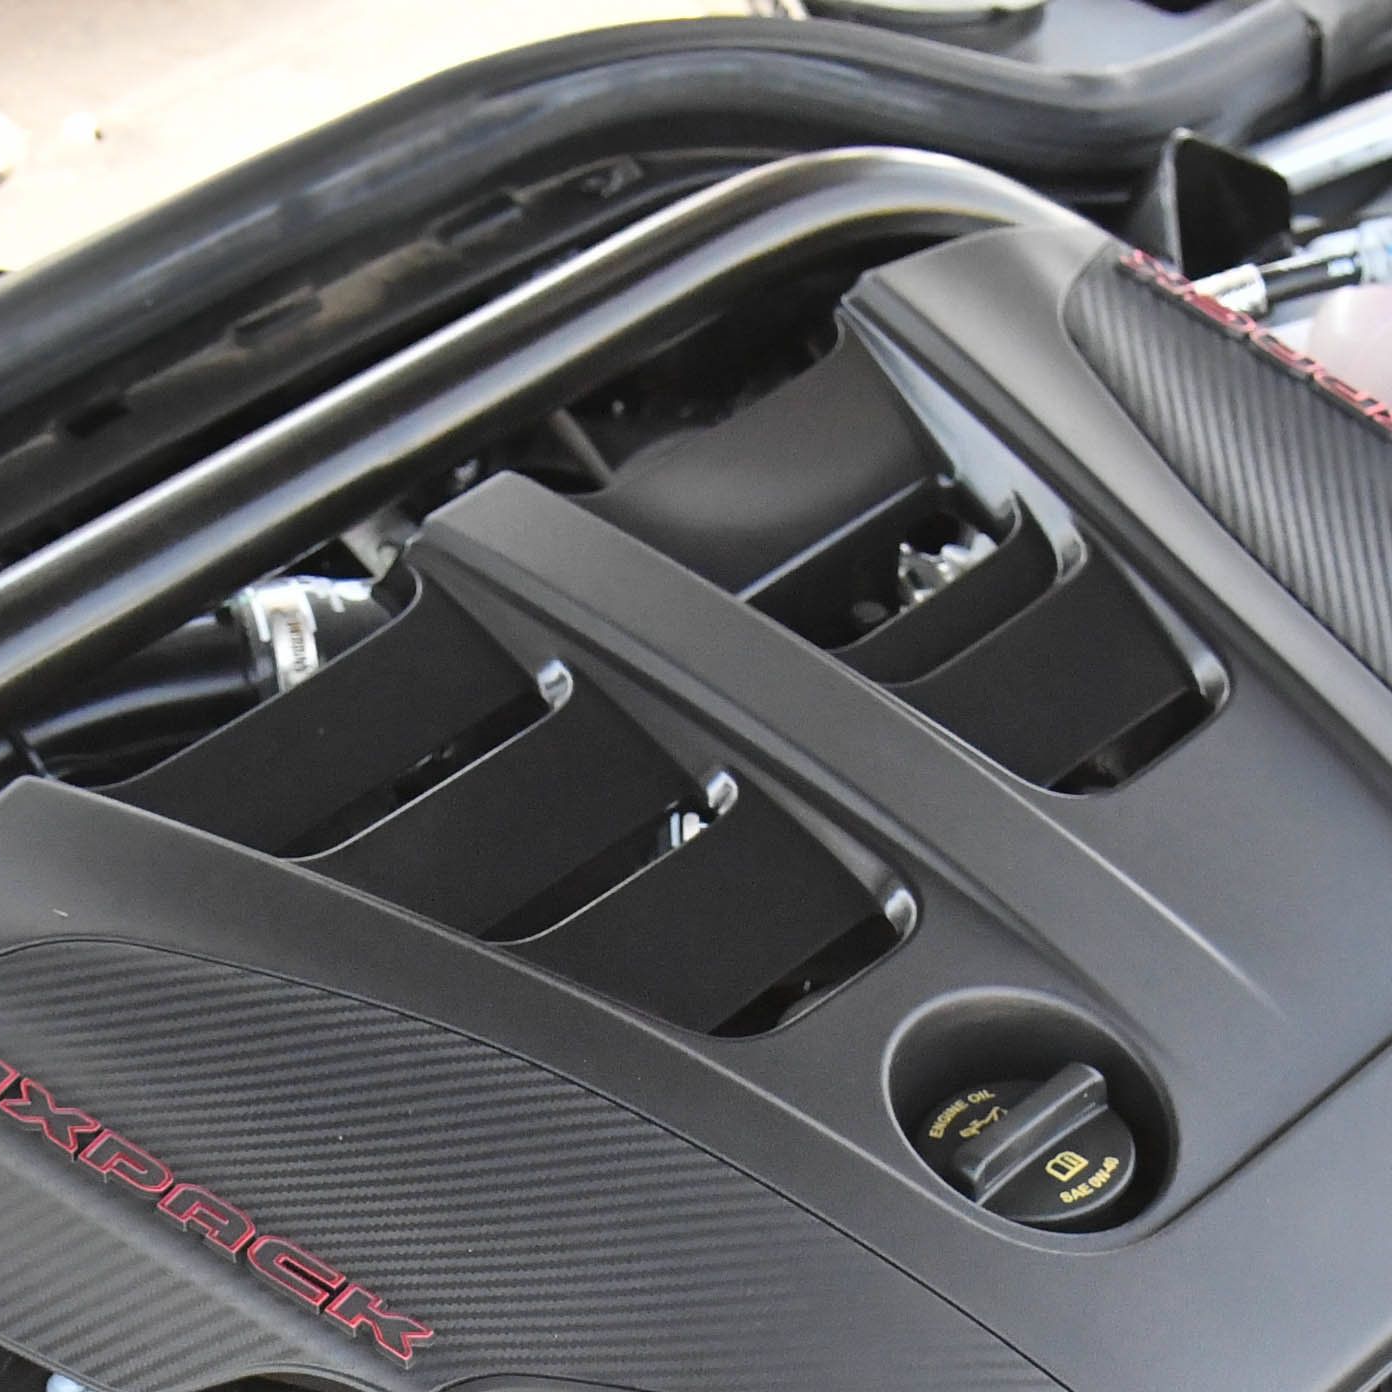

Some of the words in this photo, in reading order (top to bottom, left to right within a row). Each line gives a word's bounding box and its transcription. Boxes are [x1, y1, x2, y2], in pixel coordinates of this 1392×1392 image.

[929, 1099, 969, 1139] ENGINE
[968, 1089, 997, 1105] OIL
[1059, 1177, 1093, 1204] SAE
